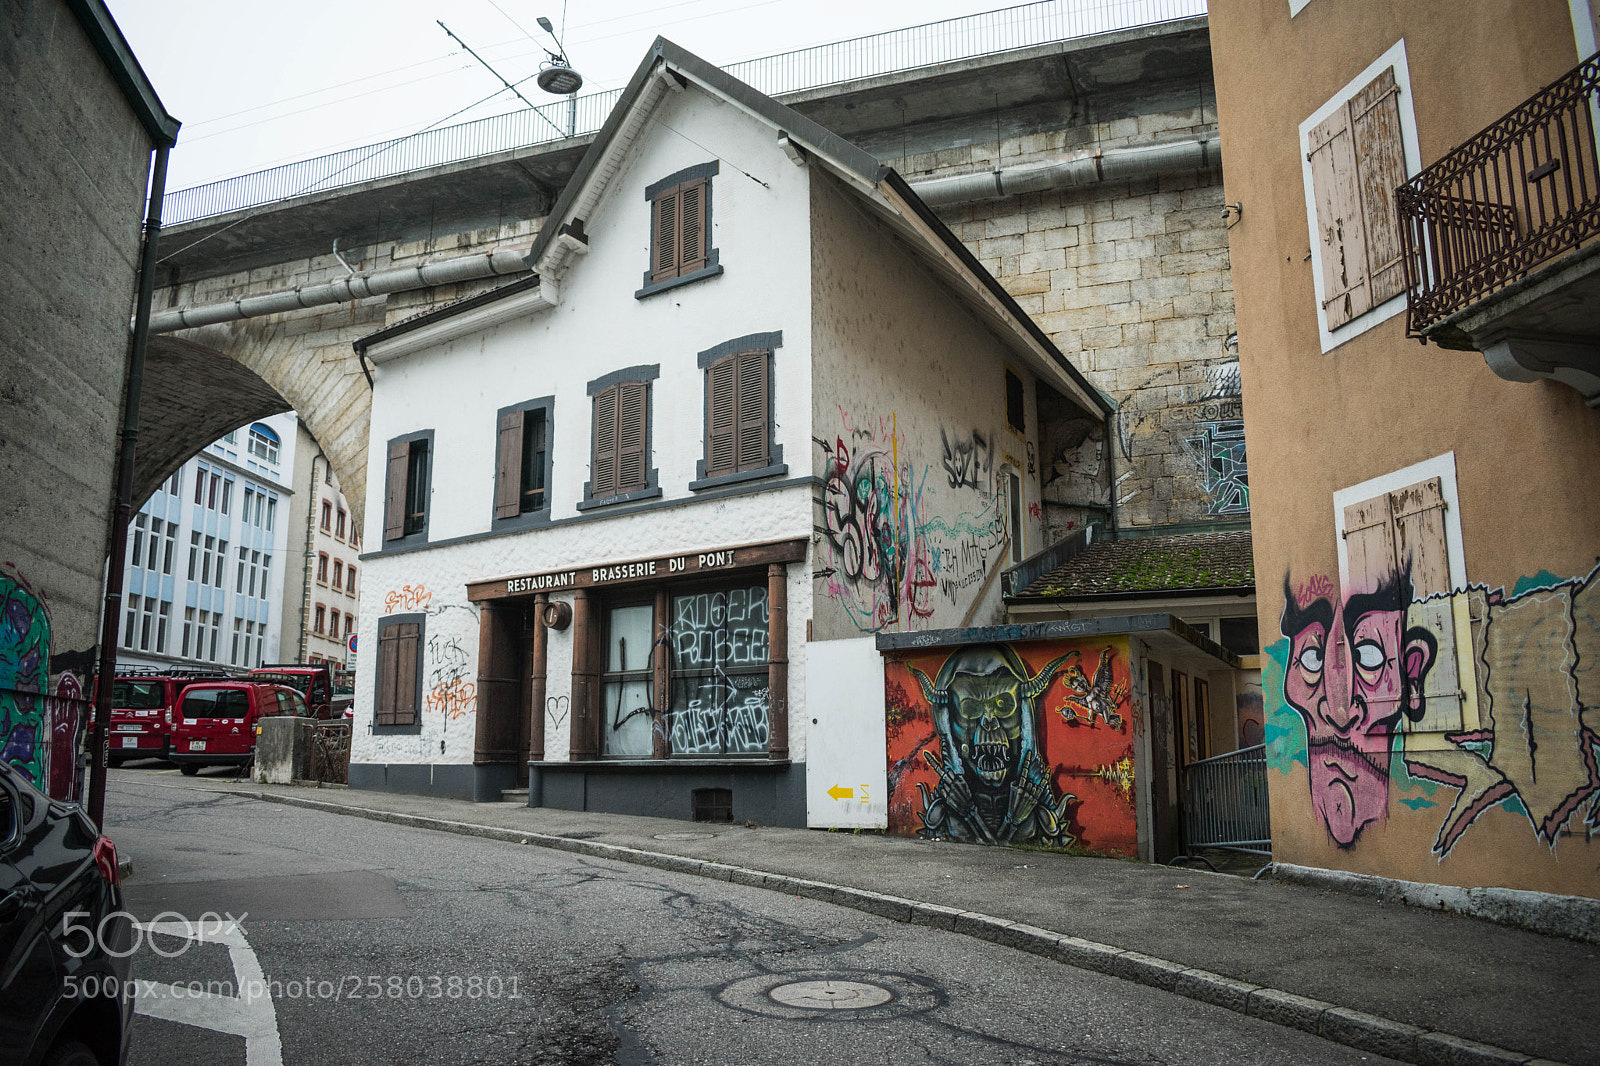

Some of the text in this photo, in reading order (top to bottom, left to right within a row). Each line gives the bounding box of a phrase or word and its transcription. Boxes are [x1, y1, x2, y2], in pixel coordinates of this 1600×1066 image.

[507, 550, 735, 592] RESTAURANT BRASSERIE DU PONT
[428, 634, 470, 665] FUCK
